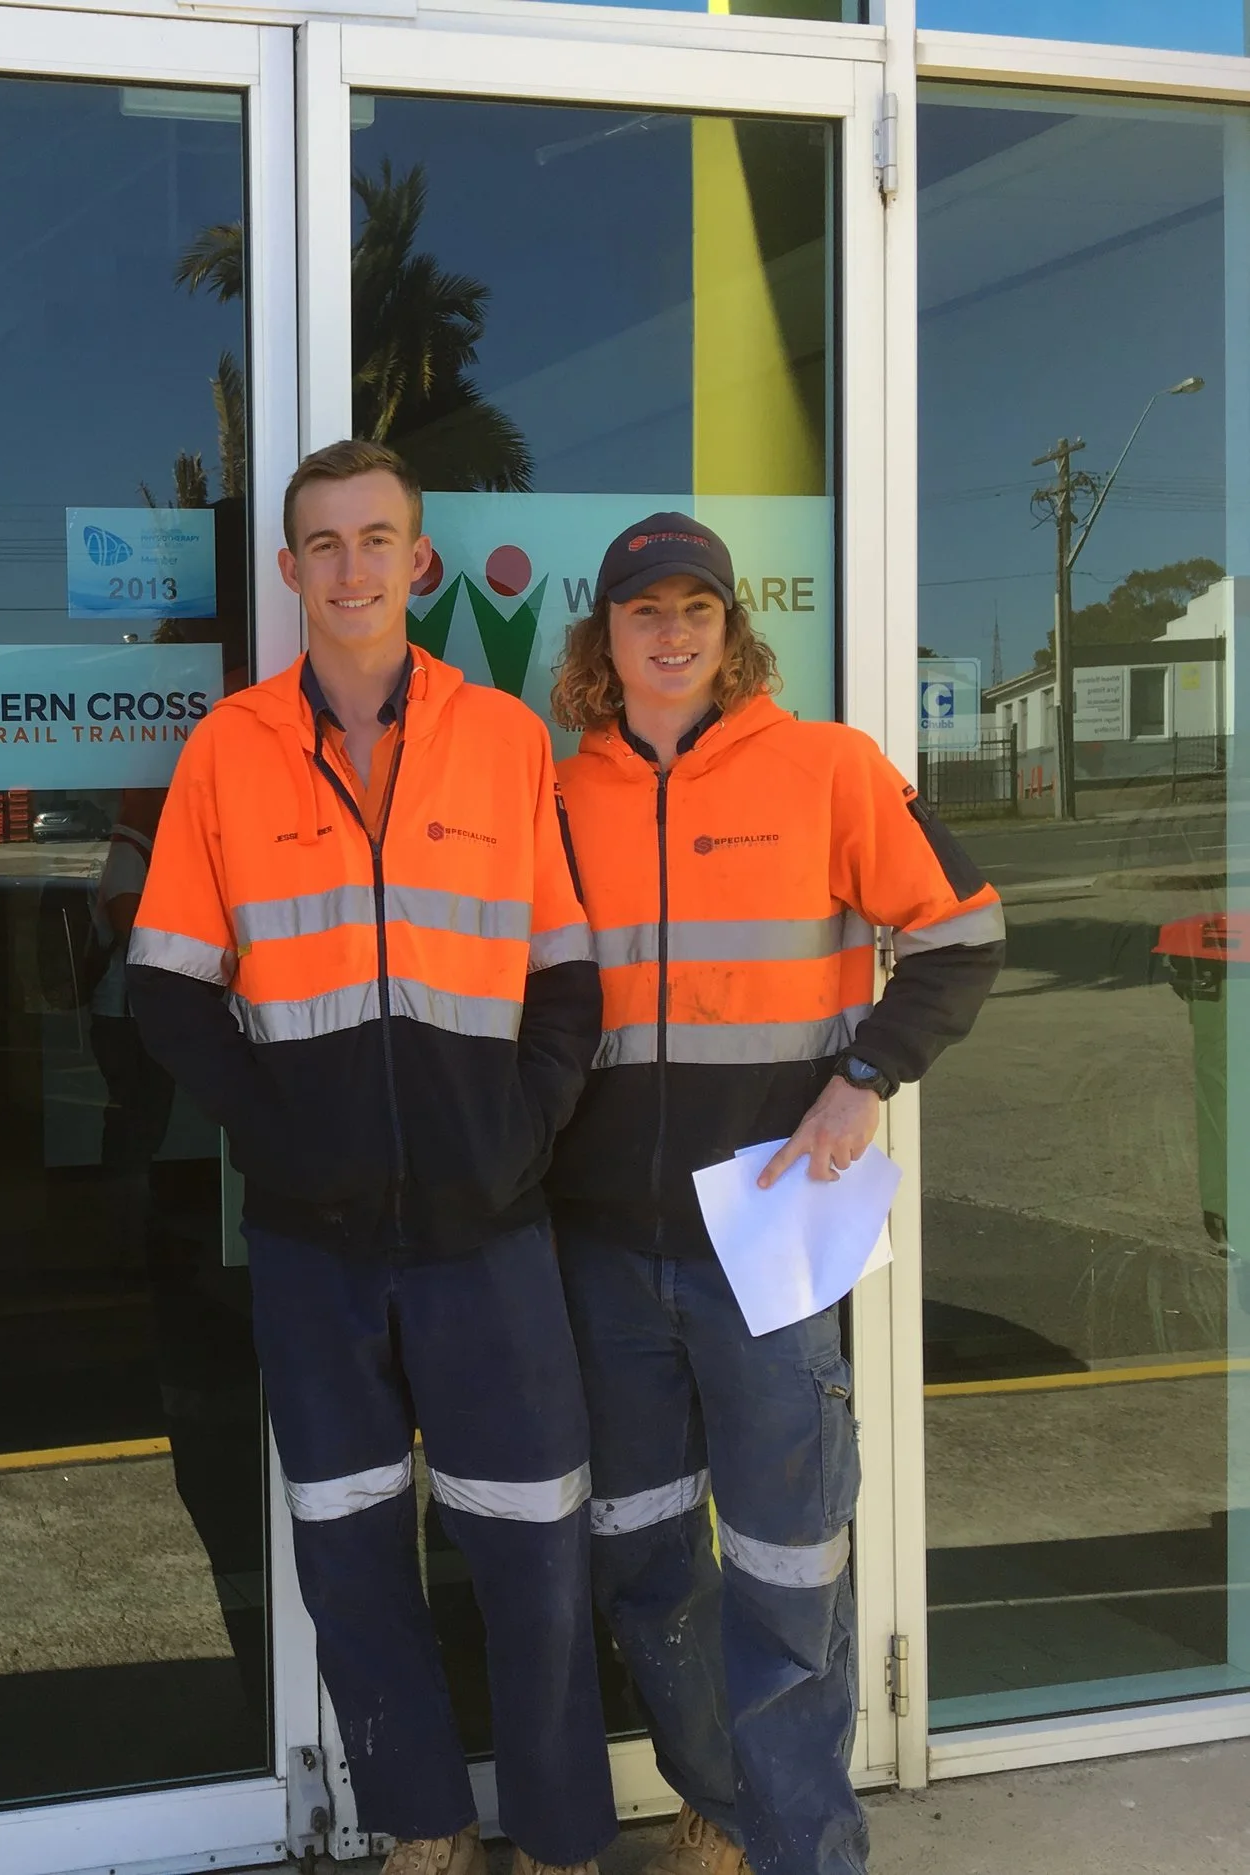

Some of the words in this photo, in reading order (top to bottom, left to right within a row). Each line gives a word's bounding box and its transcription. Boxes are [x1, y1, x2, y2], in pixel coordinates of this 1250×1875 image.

[109, 577, 178, 600] 2013
[87, 691, 209, 721] CROSS
[921, 720, 954, 729] Chubb
[71, 725, 191, 743] TRAININ
[444, 827, 498, 845] SPECIALIZED
[714, 834, 779, 845] SPECIALIZED
